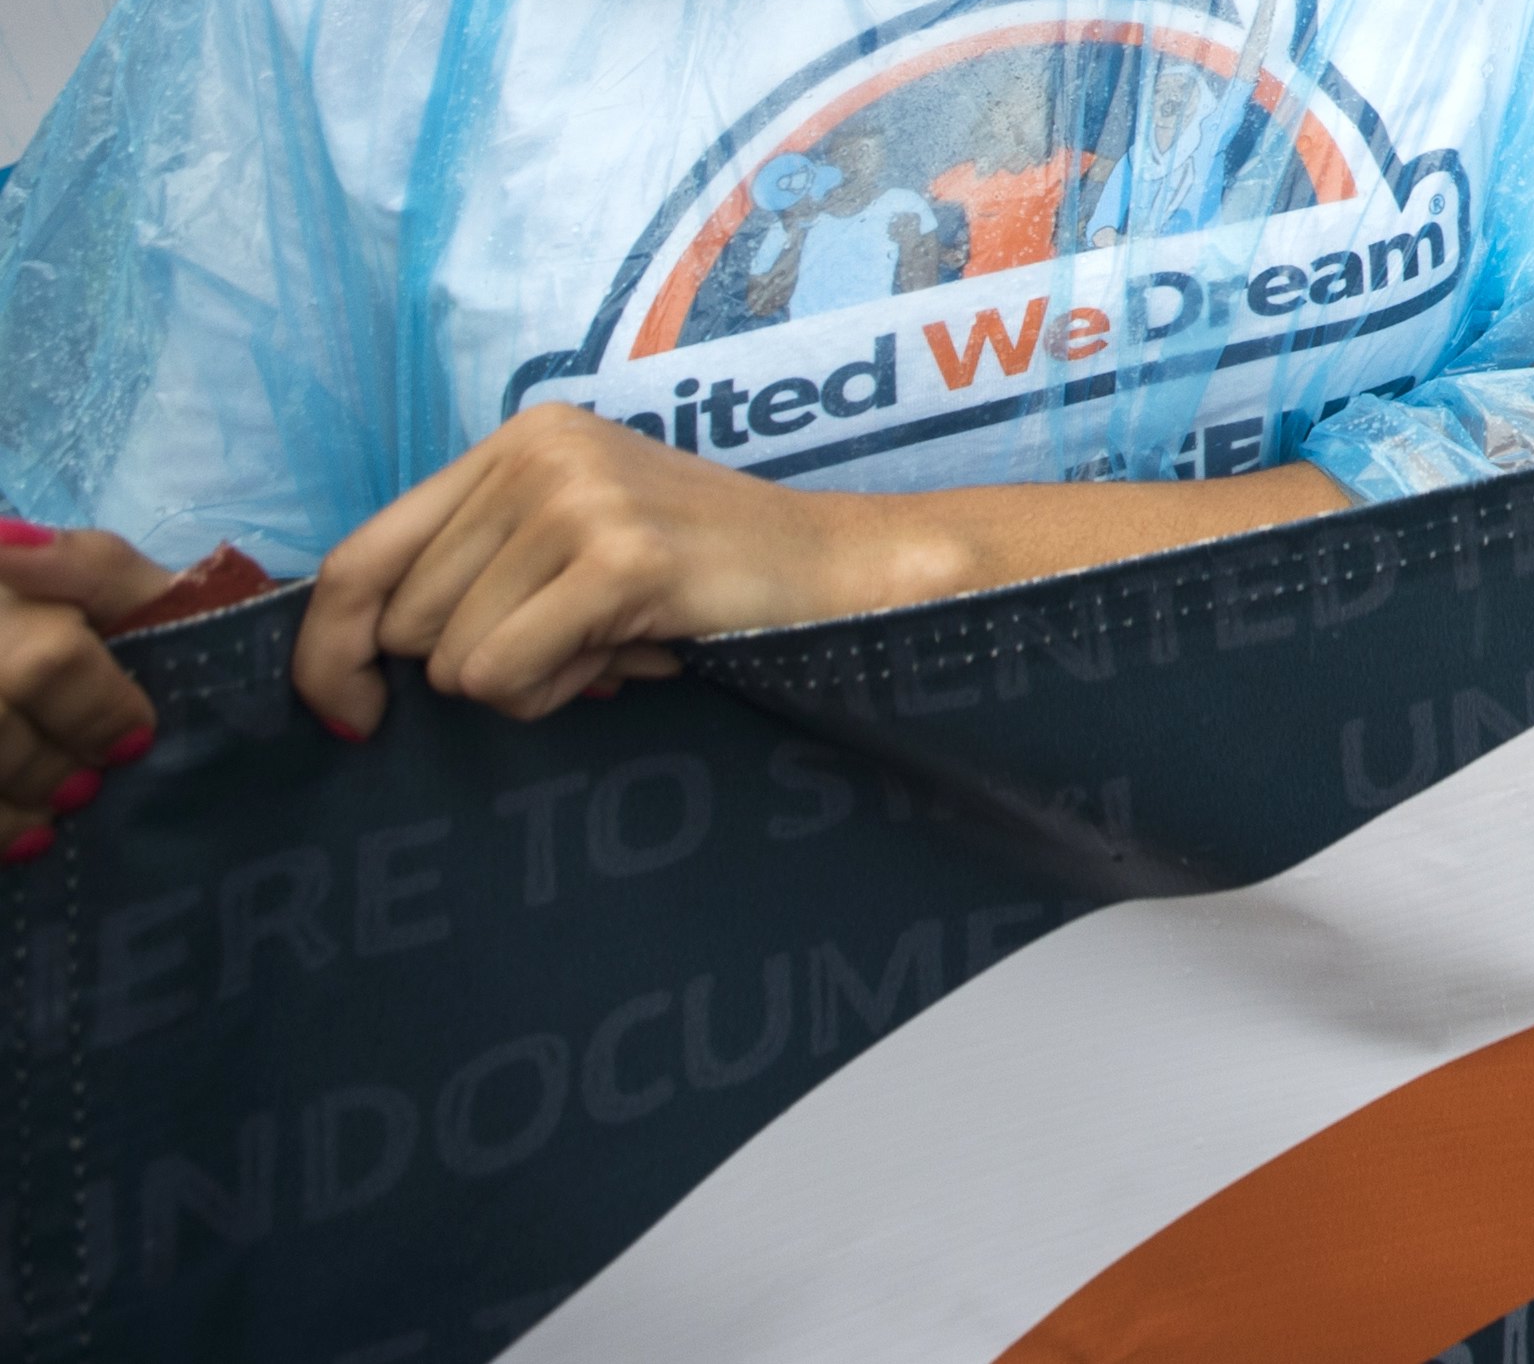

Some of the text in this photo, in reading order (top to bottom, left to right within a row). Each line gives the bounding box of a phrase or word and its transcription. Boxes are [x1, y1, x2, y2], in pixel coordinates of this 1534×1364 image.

[577, 222, 1445, 457] nited We Dream
[494, 750, 714, 908] TO
